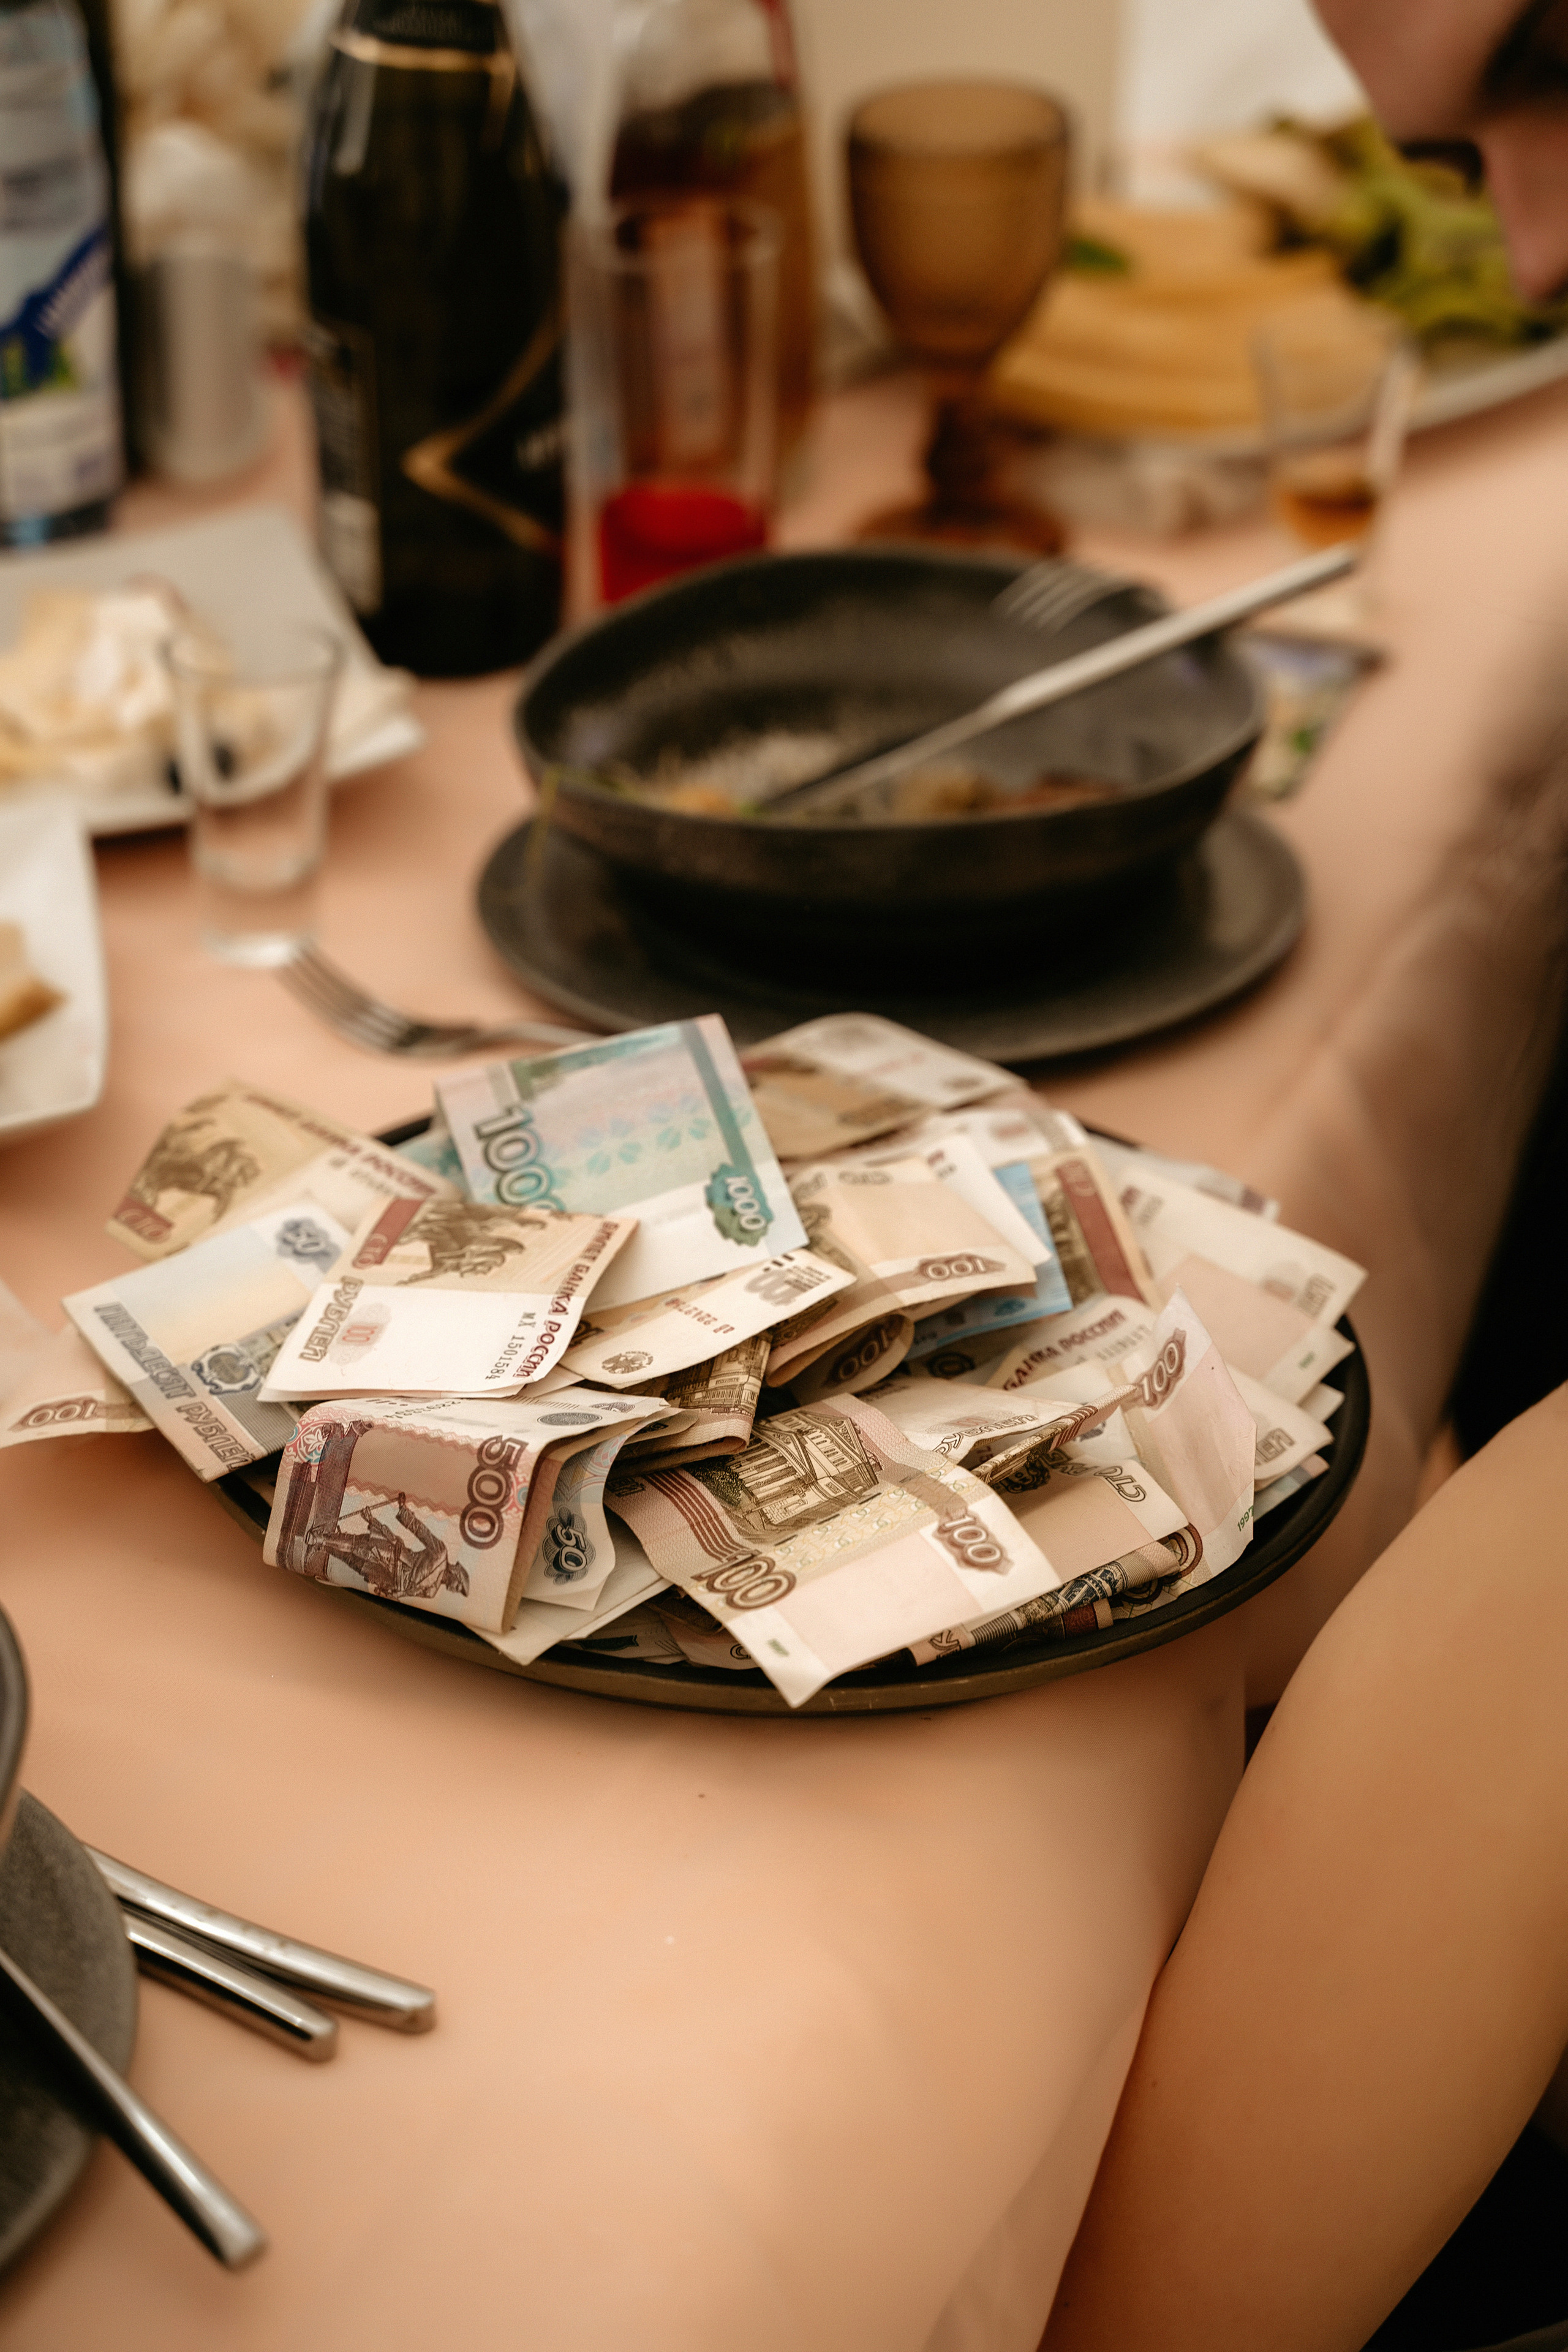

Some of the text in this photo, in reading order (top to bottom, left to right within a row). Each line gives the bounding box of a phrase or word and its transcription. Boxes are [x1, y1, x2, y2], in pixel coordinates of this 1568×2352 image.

[725, 1175, 766, 1232] 1000
[548, 1263, 590, 1315] БАНКА
[925, 1256, 986, 1281] 100
[298, 1275, 365, 1362] РУБЛЕЙ
[484, 1335, 526, 1380] 1501584
[513, 1320, 562, 1378] РОССИИ
[1139, 1343, 1180, 1403] 100
[26, 1403, 98, 1428] 100
[175, 1401, 257, 1471] РУБЛЕЙ
[459, 1434, 530, 1550] 500
[1093, 1465, 1147, 1502] СТО
[940, 1515, 1003, 1565] 100
[1237, 1505, 1254, 1532] 1997
[552, 1526, 589, 1574] 50
[691, 1548, 797, 1611] 100
